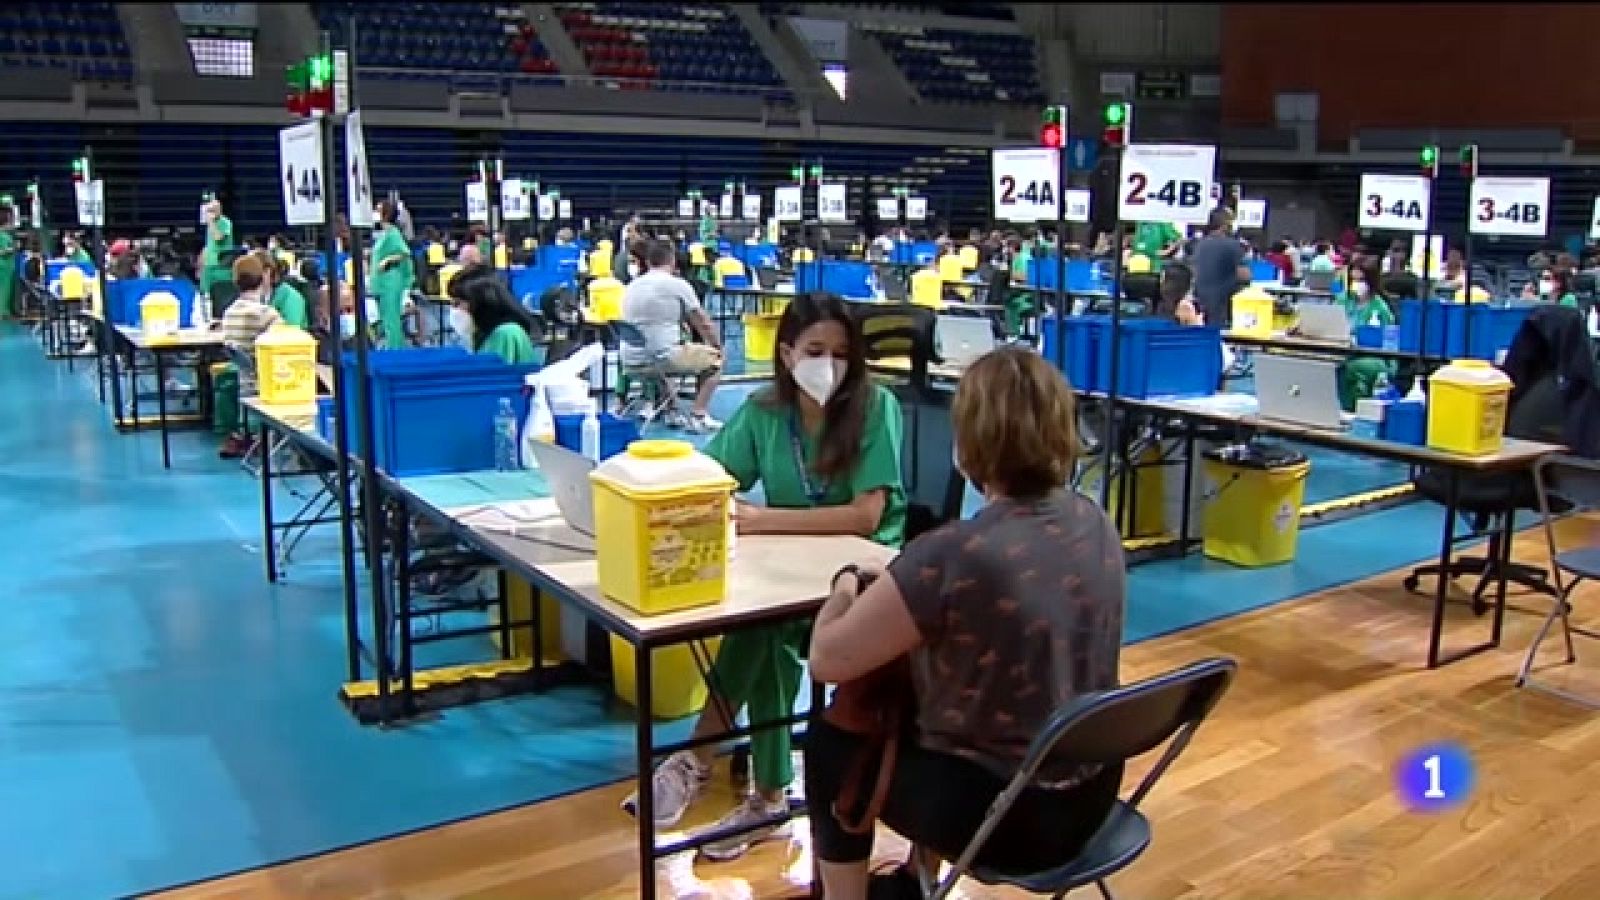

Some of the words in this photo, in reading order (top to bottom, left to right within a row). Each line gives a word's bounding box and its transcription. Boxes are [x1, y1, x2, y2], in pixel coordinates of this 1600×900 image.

[1000, 174, 1055, 206] 2-4A
[1125, 172, 1202, 207] 2-4B
[1366, 194, 1422, 219] 3-4A
[1477, 197, 1541, 223] 3-4B
